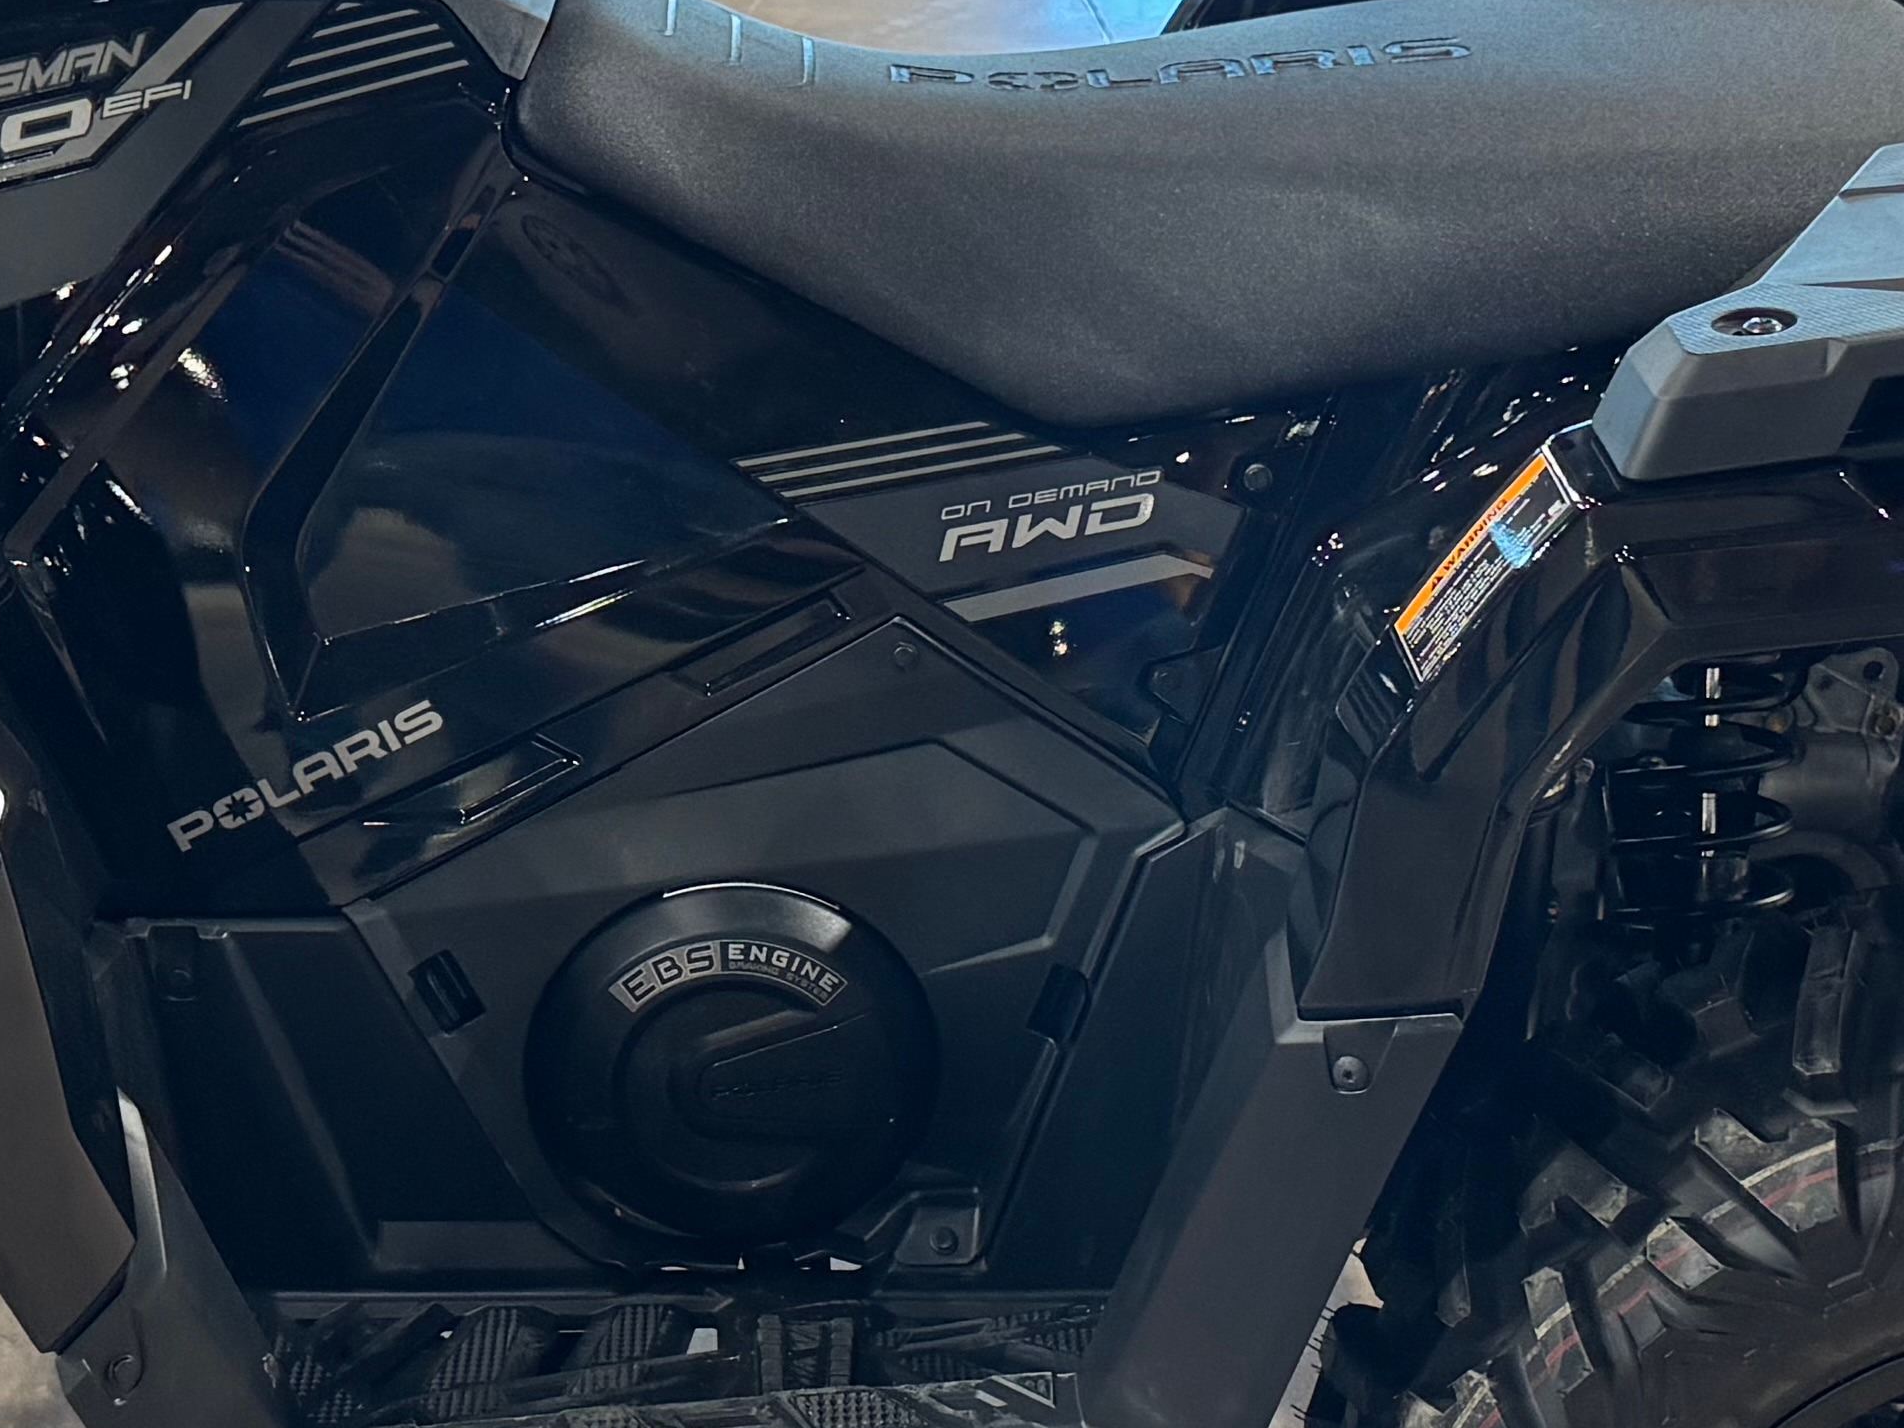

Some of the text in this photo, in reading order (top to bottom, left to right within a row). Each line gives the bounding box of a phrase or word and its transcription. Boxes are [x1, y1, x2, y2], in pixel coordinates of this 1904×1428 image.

[887, 33, 1472, 95] POLARIS
[101, 79, 193, 122] EFI
[939, 467, 1162, 520] ON DEMAND
[937, 493, 1157, 562] AWD
[1441, 498, 1509, 573] WARNING
[166, 698, 444, 853] POLARIS
[620, 942, 842, 1004] EBS ENGINE
